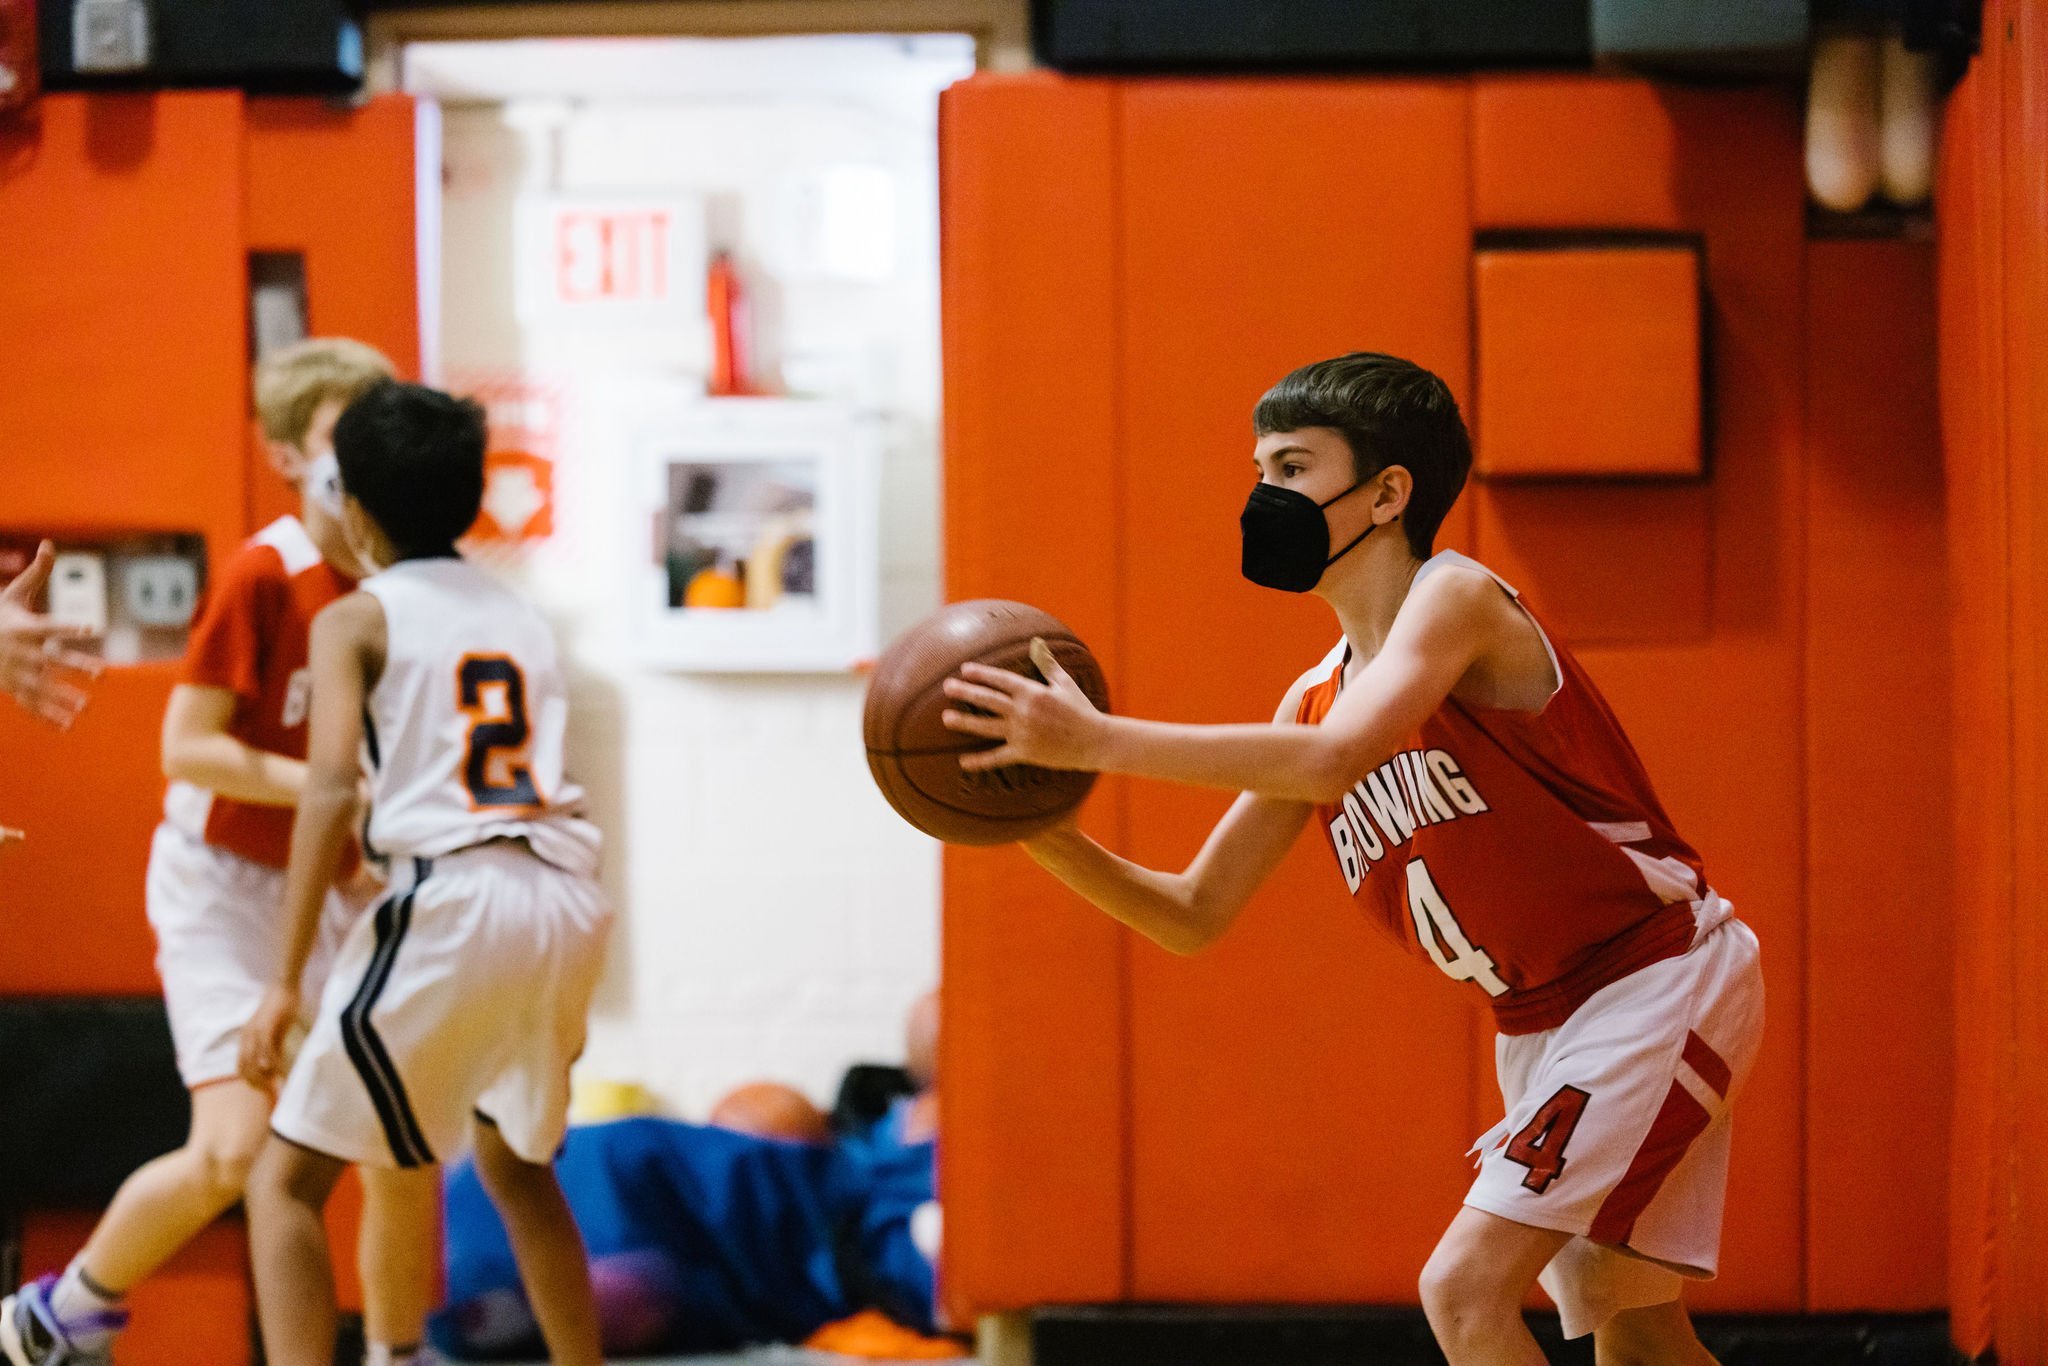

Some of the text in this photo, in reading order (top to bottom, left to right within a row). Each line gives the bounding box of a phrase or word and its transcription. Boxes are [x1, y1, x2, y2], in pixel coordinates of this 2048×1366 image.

[557, 211, 669, 302] EXIT
[456, 652, 543, 812] 2
[1405, 855, 1511, 998] 4
[1504, 1084, 1592, 1195] 4
